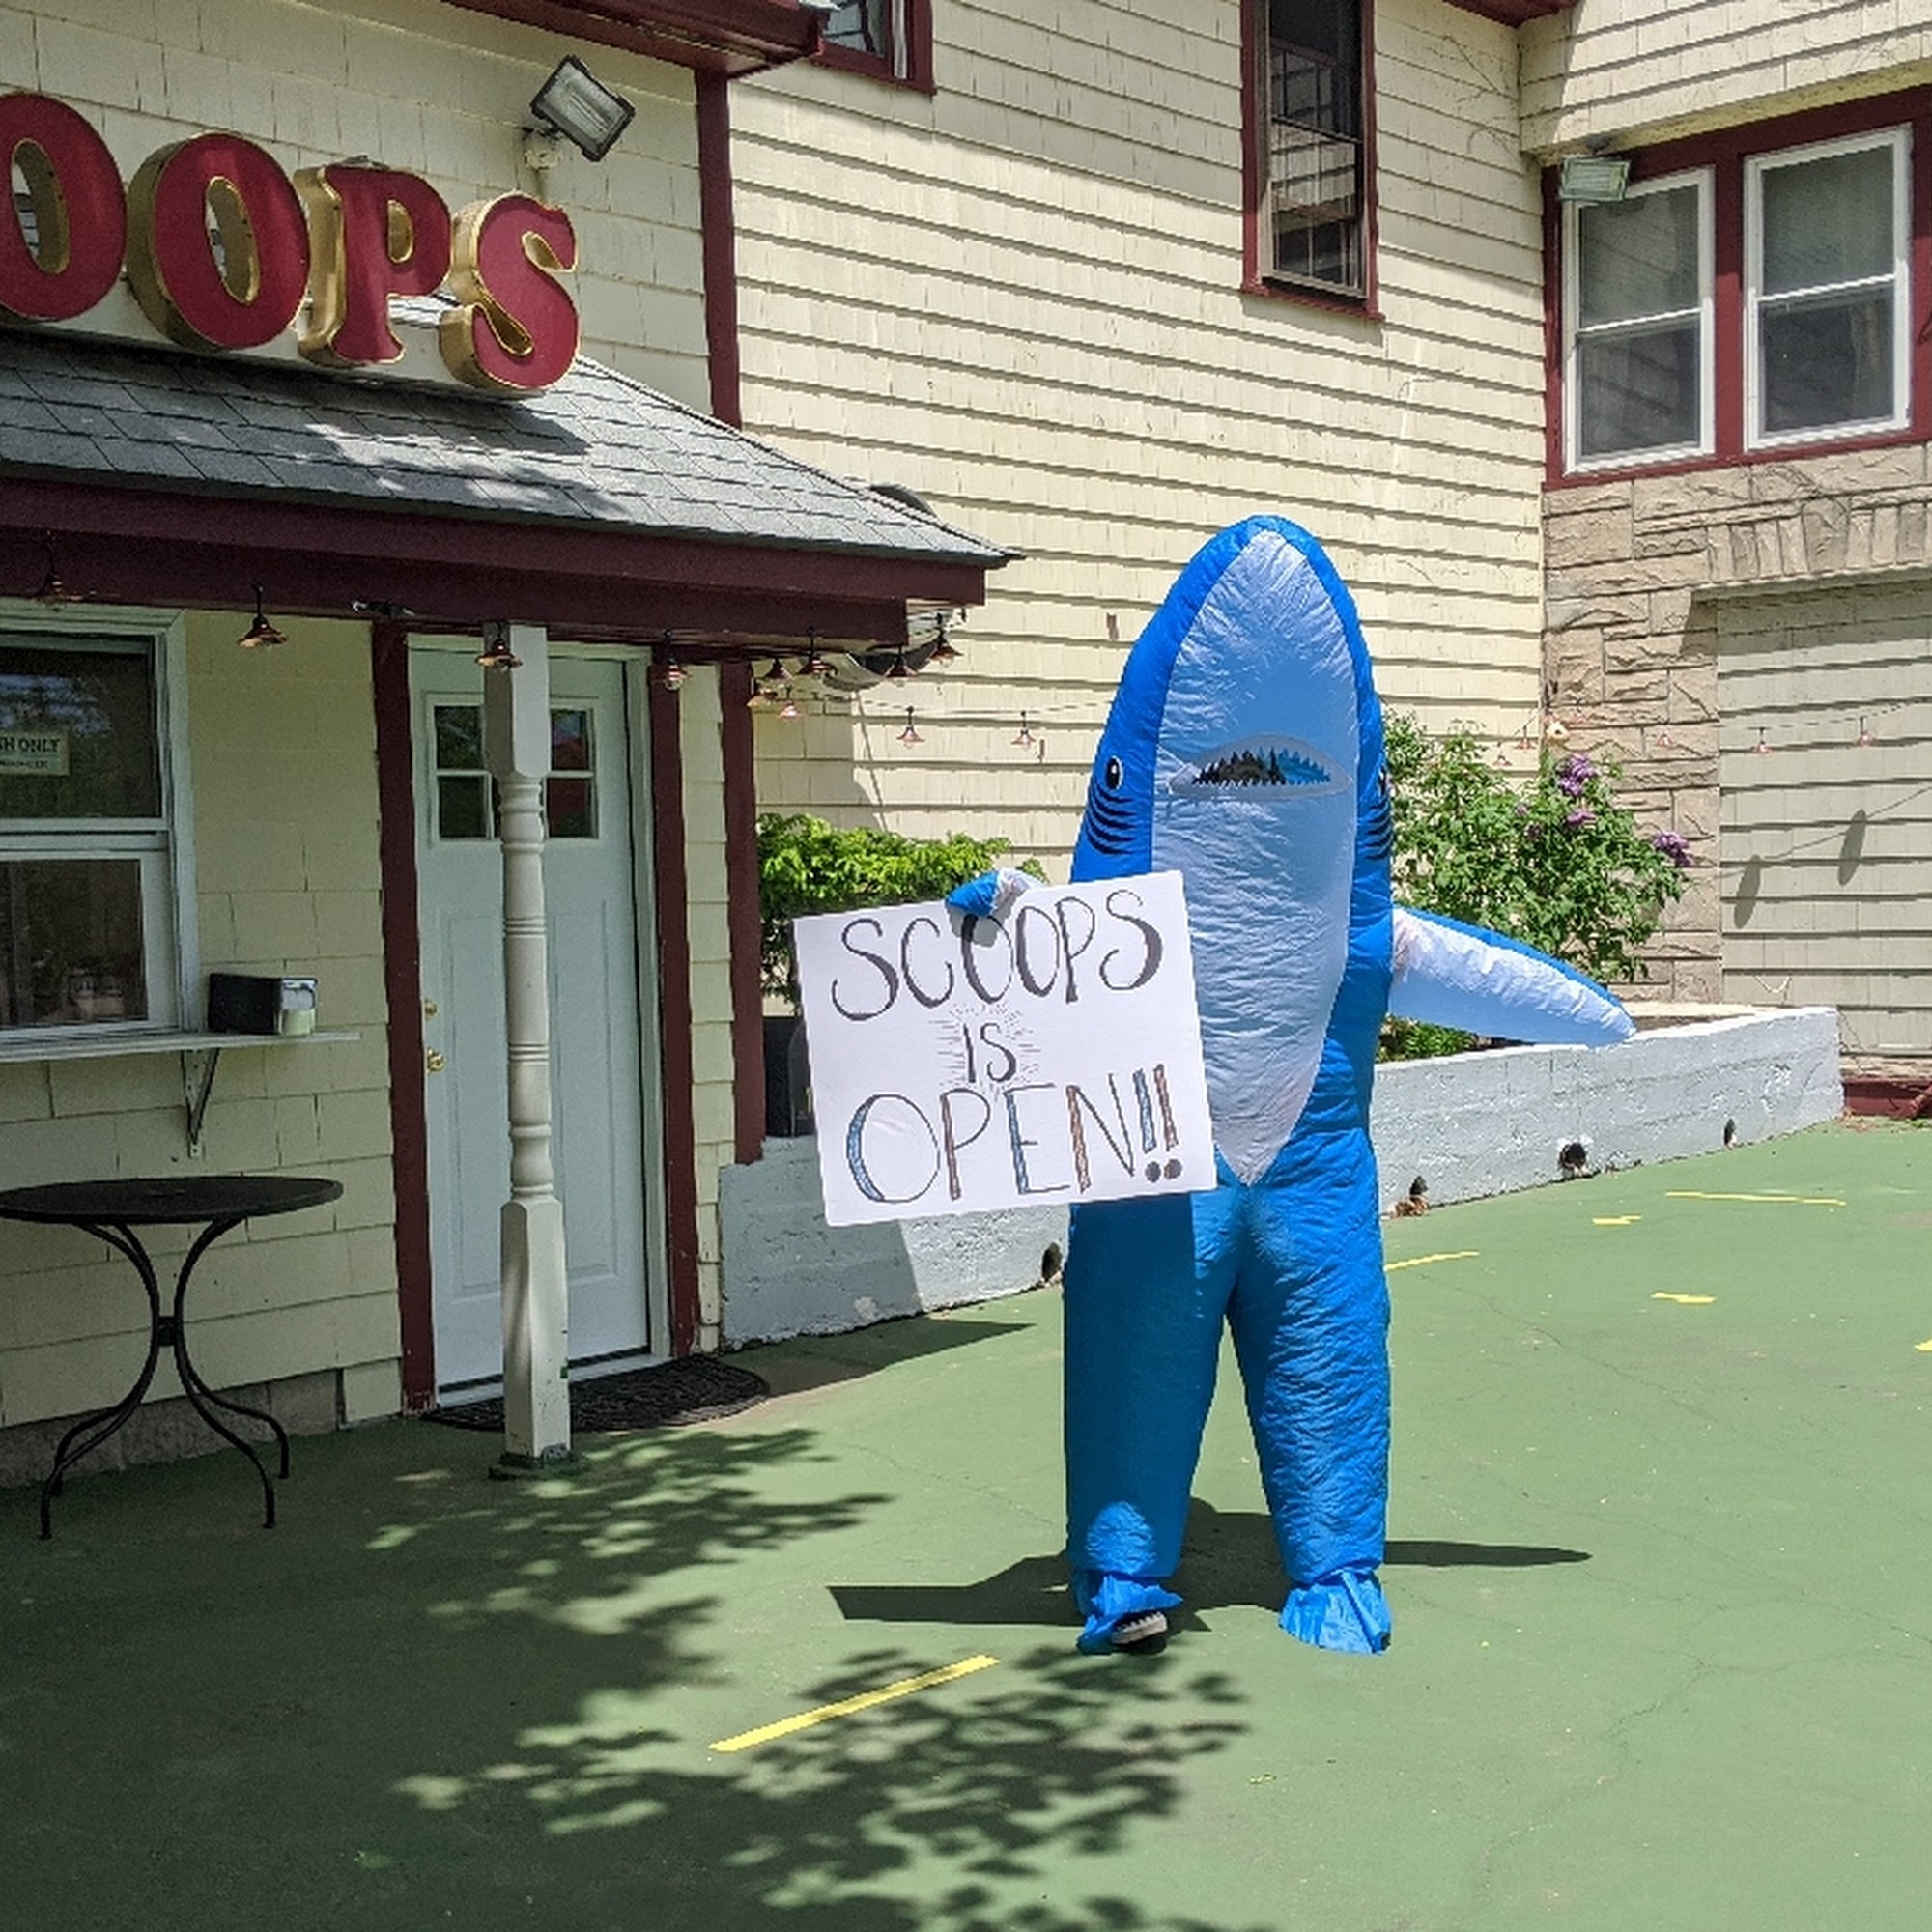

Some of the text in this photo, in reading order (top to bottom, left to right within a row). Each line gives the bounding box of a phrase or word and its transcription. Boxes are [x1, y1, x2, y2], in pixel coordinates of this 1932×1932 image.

[0, 93, 580, 390] OOPS
[18, 738, 60, 753] ONLY
[831, 889, 1163, 1021] SCOOPS
[963, 1022, 1017, 1083] IS
[845, 1064, 1183, 1204] OPEN!!
